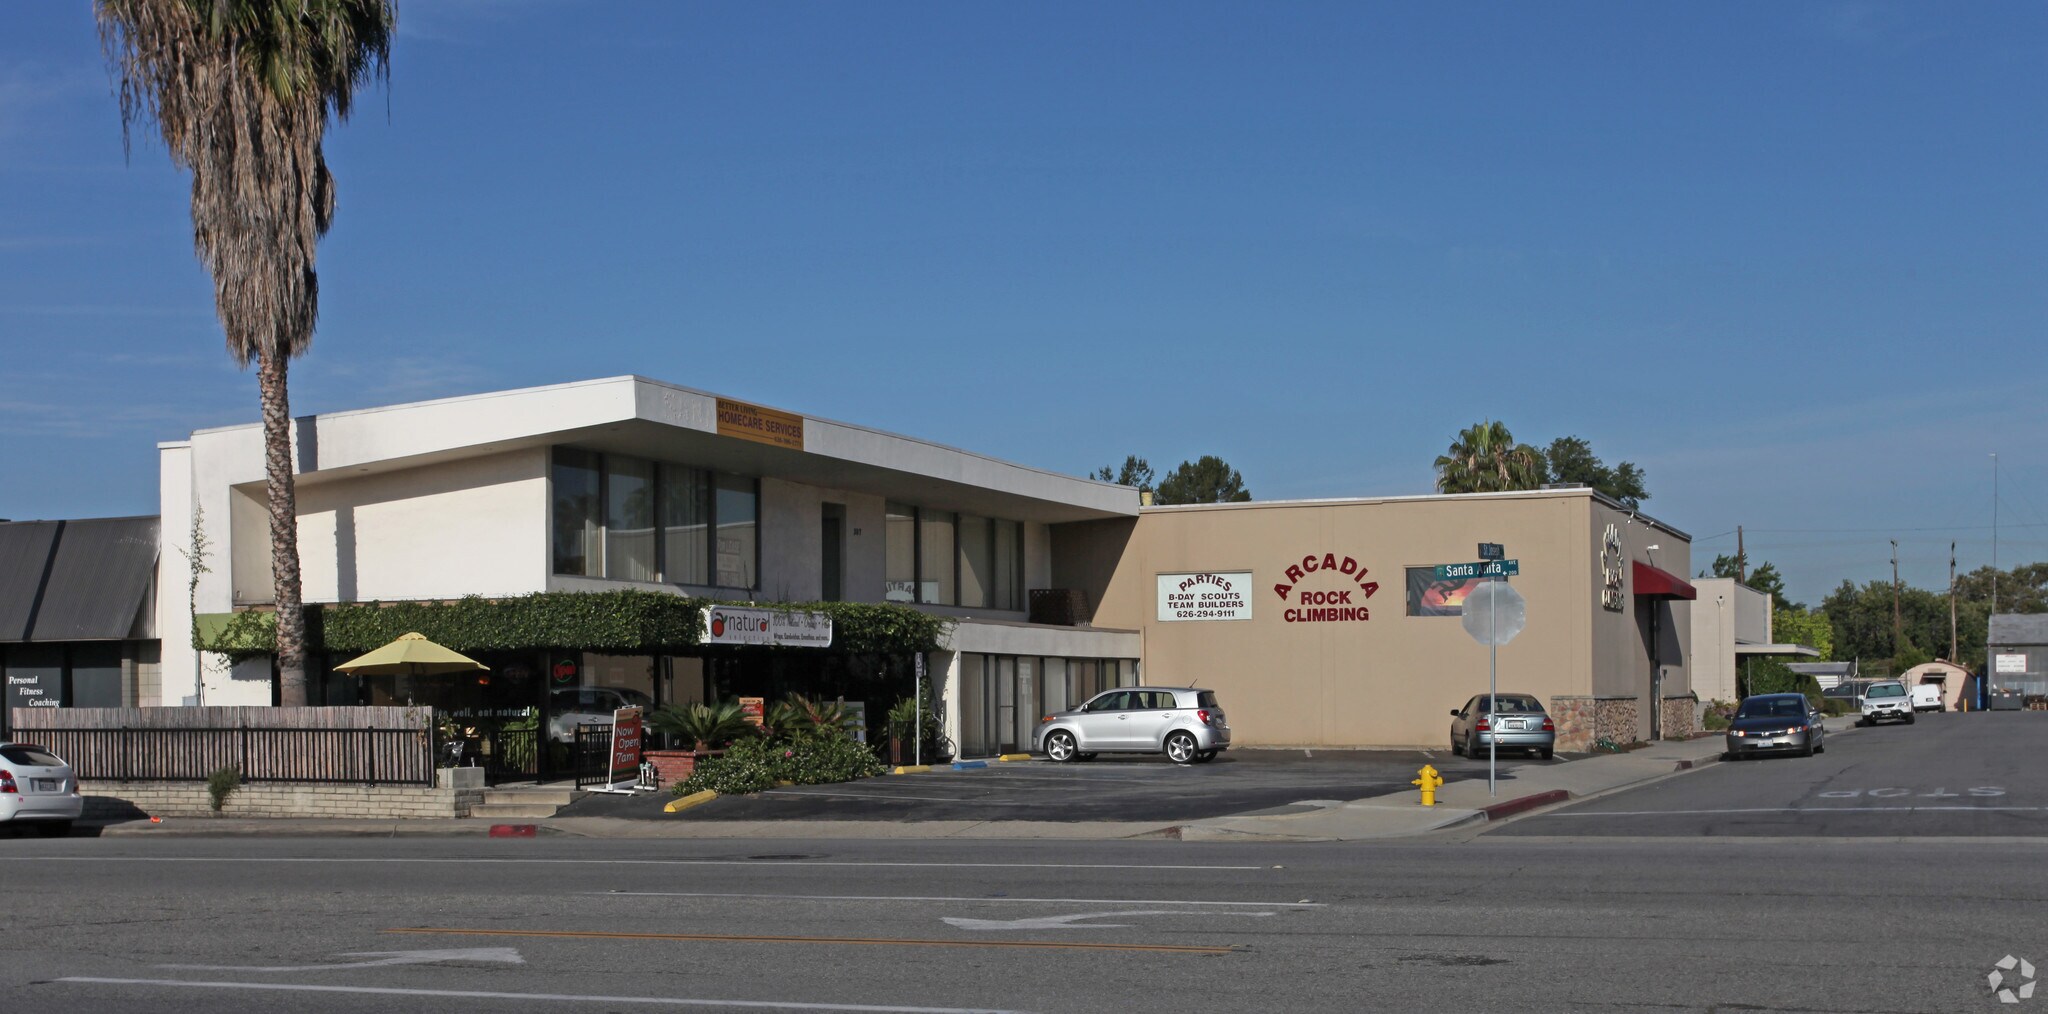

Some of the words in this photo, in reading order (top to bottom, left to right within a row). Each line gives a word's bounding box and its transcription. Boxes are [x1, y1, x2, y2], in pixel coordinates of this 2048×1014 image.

[718, 401, 739, 412] BETTER
[740, 405, 758, 416] LIVING
[718, 410, 763, 430] HOMECARE
[765, 420, 801, 438] SERVICES
[1446, 565, 1473, 577] Santa
[1477, 563, 1501, 575] Anita
[1179, 573, 1232, 592] PARTIES
[1274, 553, 1379, 601] ARCADIA
[1168, 593, 1195, 601] B-DAY
[1201, 592, 1240, 600] SCOUTS
[1301, 591, 1352, 605] ROCK
[1167, 601, 1194, 609] TEAM
[1198, 600, 1244, 608] BUILDERS
[1176, 610, 1235, 618] 626-294-9111
[1284, 607, 1369, 622] CLIMBING
[729, 612, 770, 632] natural
[9, 675, 38, 684] Personal
[19, 687, 44, 696] Fitness
[29, 698, 60, 709] Coaching
[496, 706, 530, 717] natural
[616, 727, 634, 737] Now
[618, 738, 639, 750] Open
[616, 752, 635, 765] 7am
[1818, 786, 2006, 798] STOP
